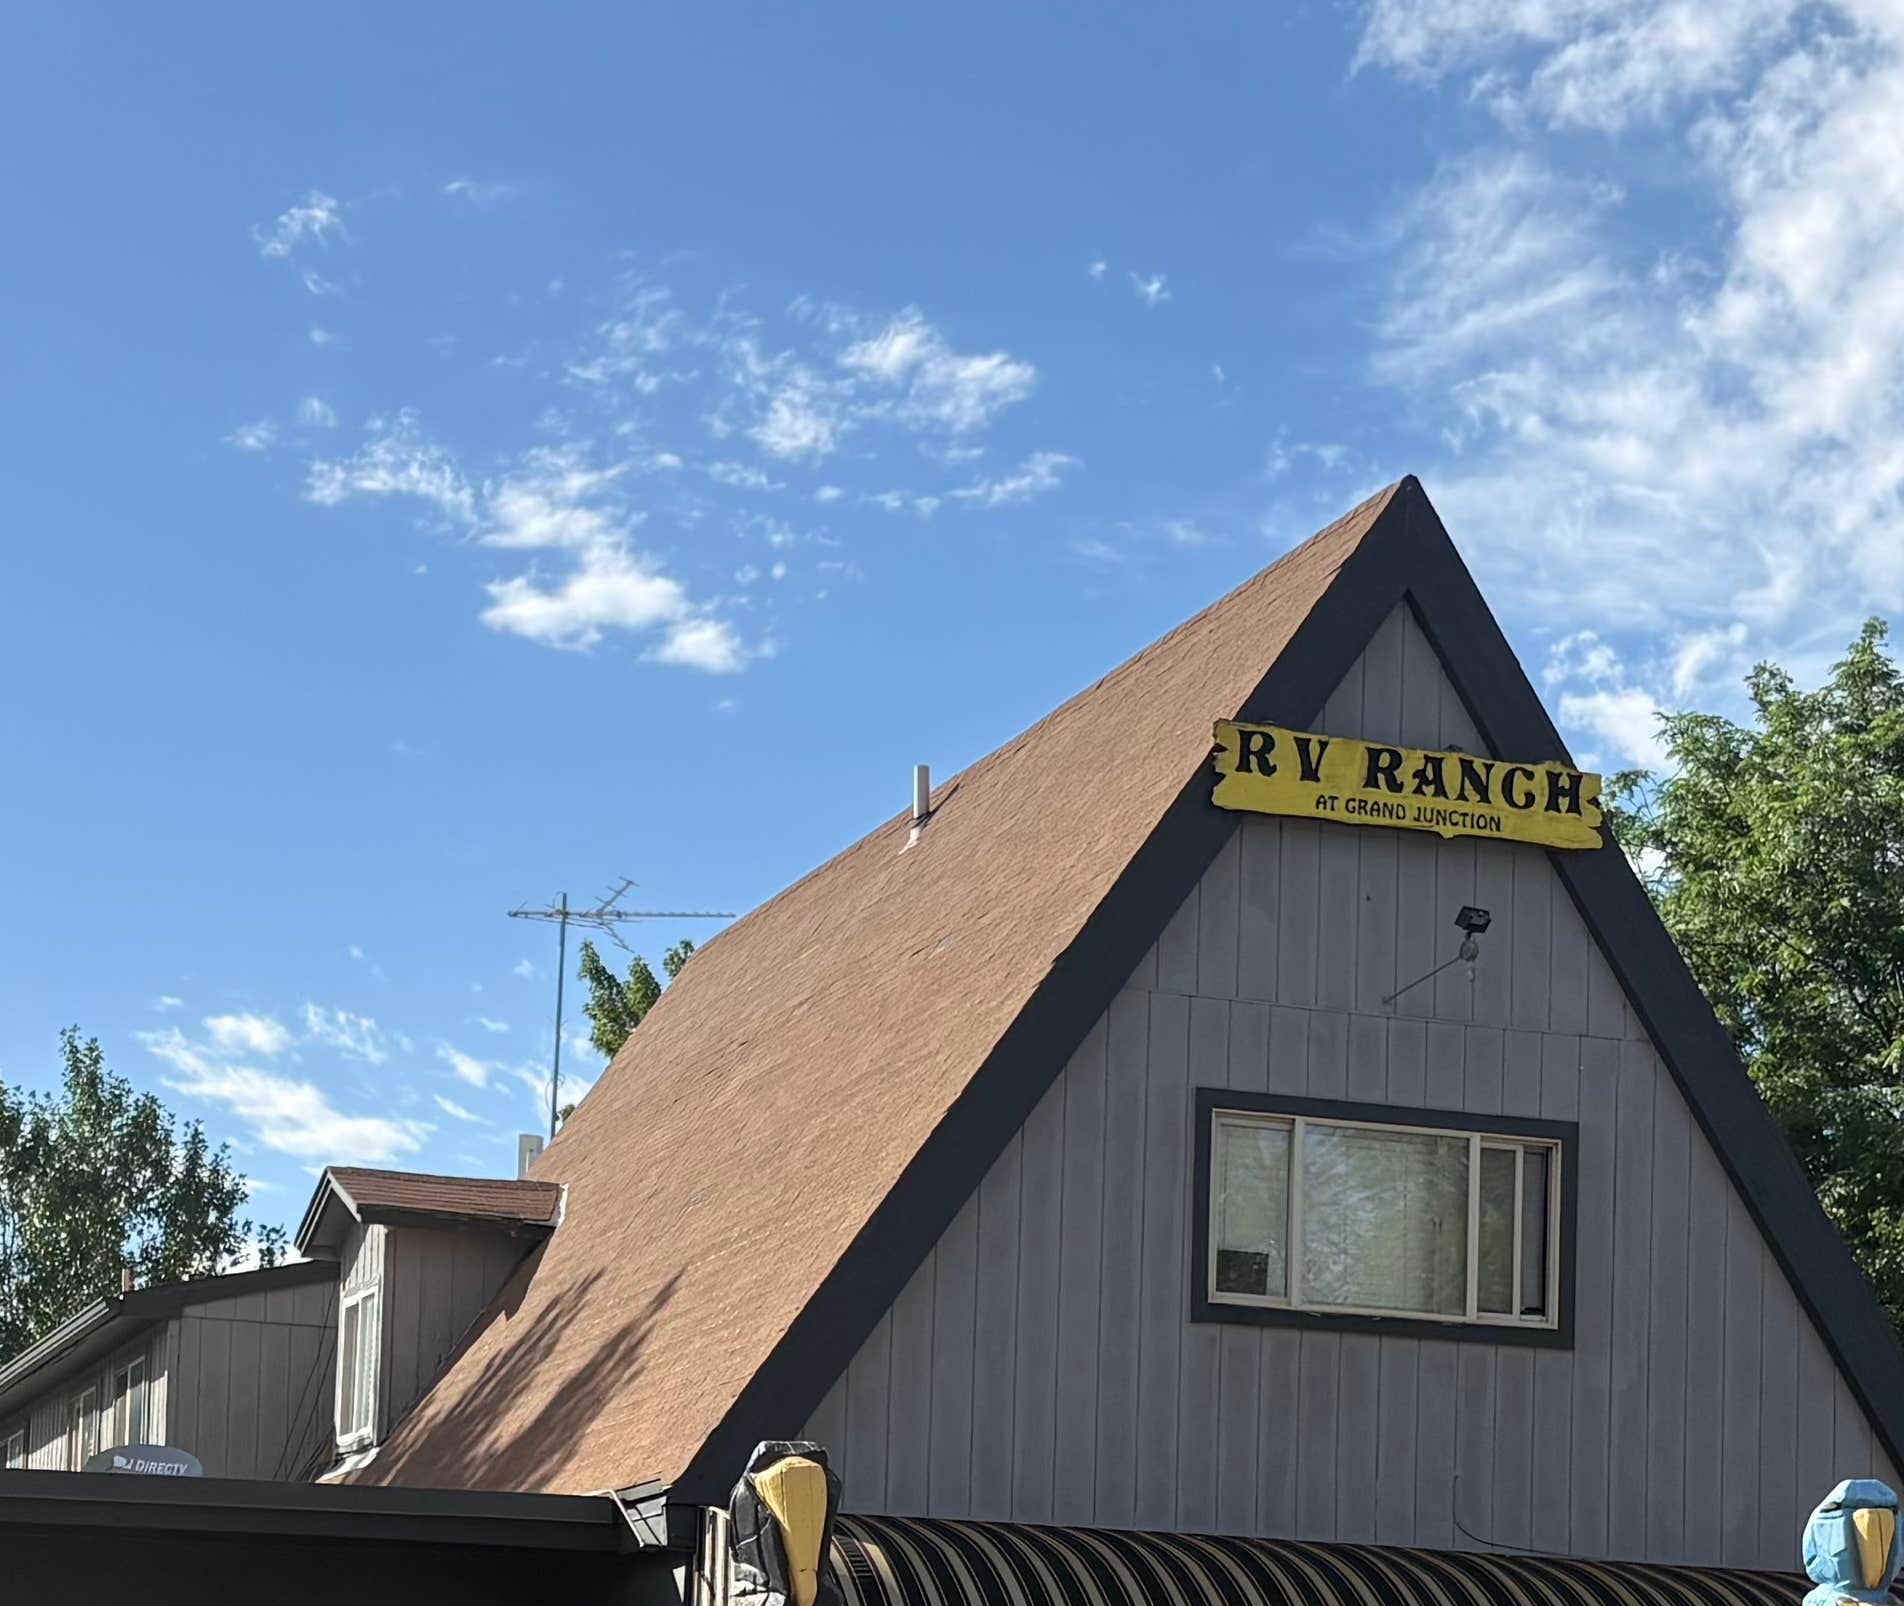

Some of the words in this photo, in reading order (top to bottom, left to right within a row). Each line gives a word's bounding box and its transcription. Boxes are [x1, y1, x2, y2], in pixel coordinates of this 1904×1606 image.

[1235, 728, 1330, 783] RV
[1361, 746, 1584, 817] RANCH
[1315, 795, 1338, 812] AT
[1345, 798, 1406, 821] GRAND
[1413, 806, 1502, 833] JUNCTION
[135, 1460, 188, 1475] DIRECTV
